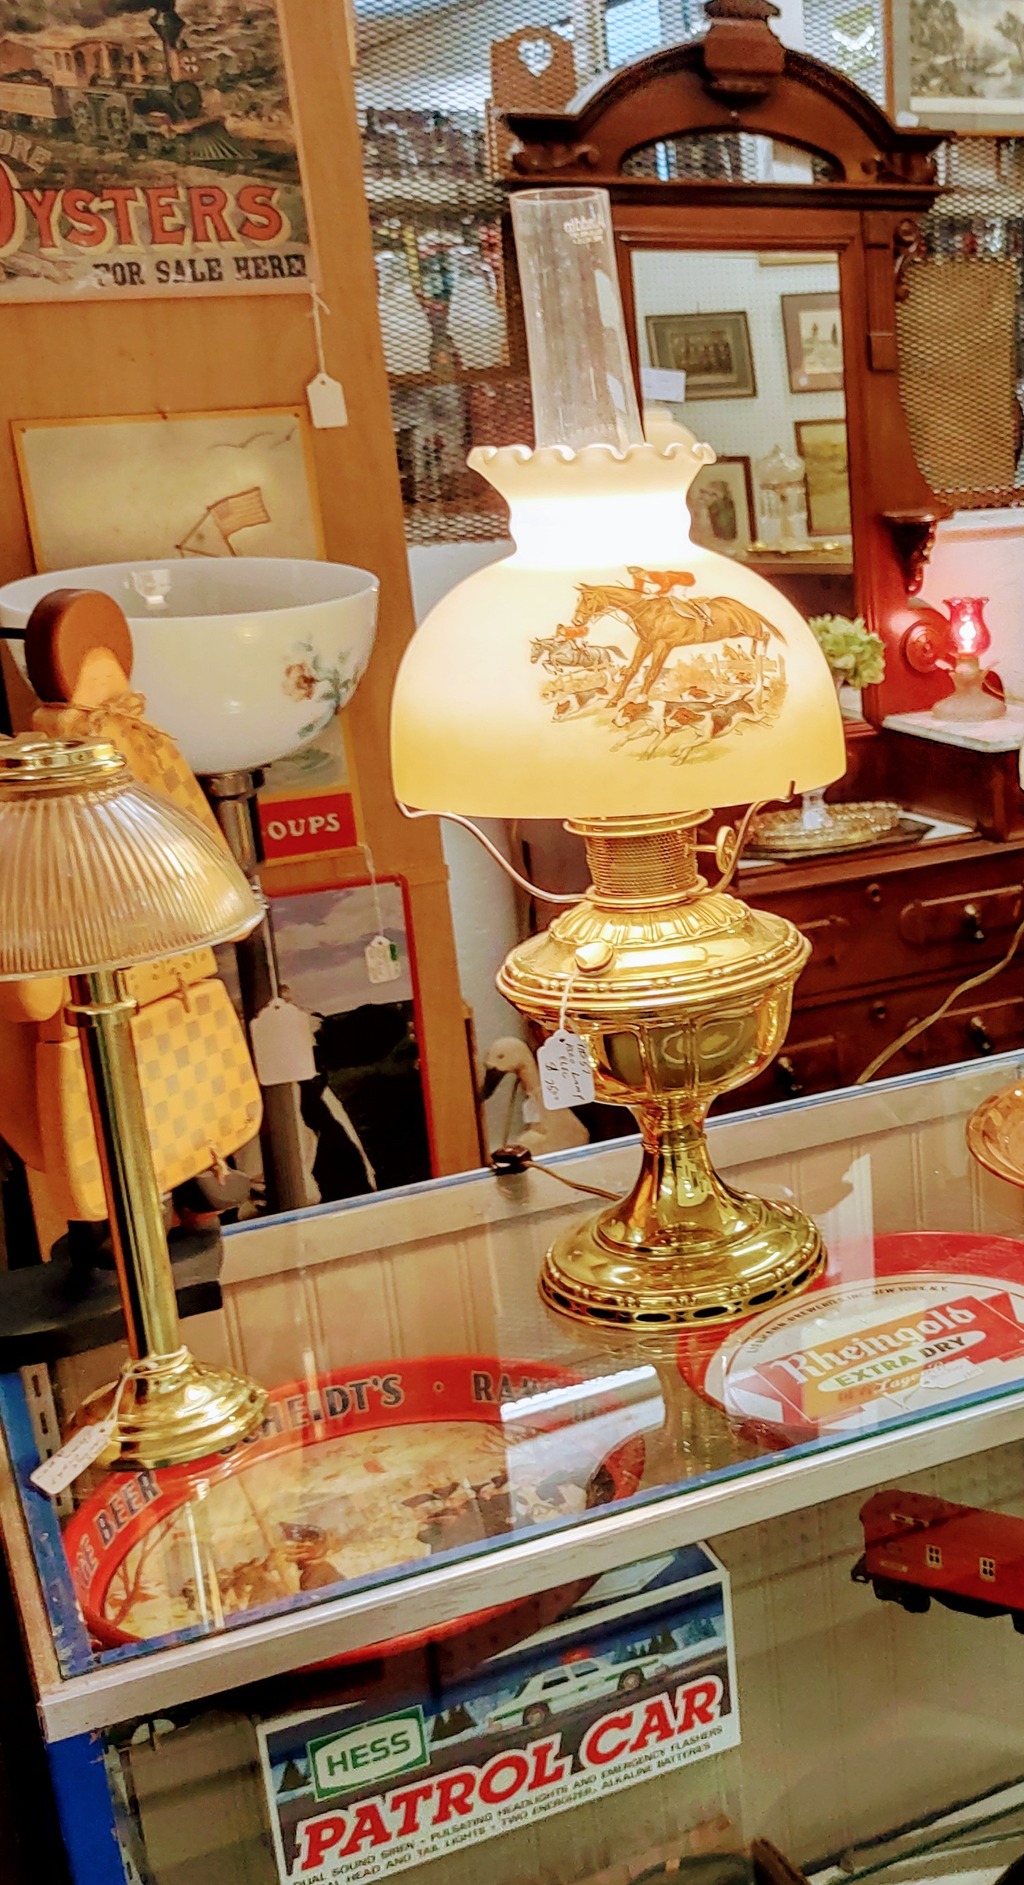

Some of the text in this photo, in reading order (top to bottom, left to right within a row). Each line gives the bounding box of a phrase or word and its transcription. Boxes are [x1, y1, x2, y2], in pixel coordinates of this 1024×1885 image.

[92, 262, 146, 286] FOR
[155, 257, 224, 284] SALE
[267, 812, 340, 840] OUPS
[769, 1306, 977, 1384] Rheingold
[834, 1354, 917, 1387] EXTRA
[918, 1336, 966, 1359] DRY
[93, 1471, 162, 1549] BEER
[219, 1375, 404, 1455] HEIDT'S
[301, 1681, 718, 1871] PATROL CAR
[326, 1730, 412, 1777] HESS
[332, 1854, 376, 1877] SOUND
[573, 1774, 597, 1789] AND
[601, 1748, 666, 1779] EMERGENCY
[670, 1725, 724, 1752] FLASHERS
[346, 1865, 381, 1883] HEAD
[386, 1853, 412, 1870] AND
[601, 1764, 652, 1789] ALKALINE
[657, 1741, 711, 1768] BATTERIES
